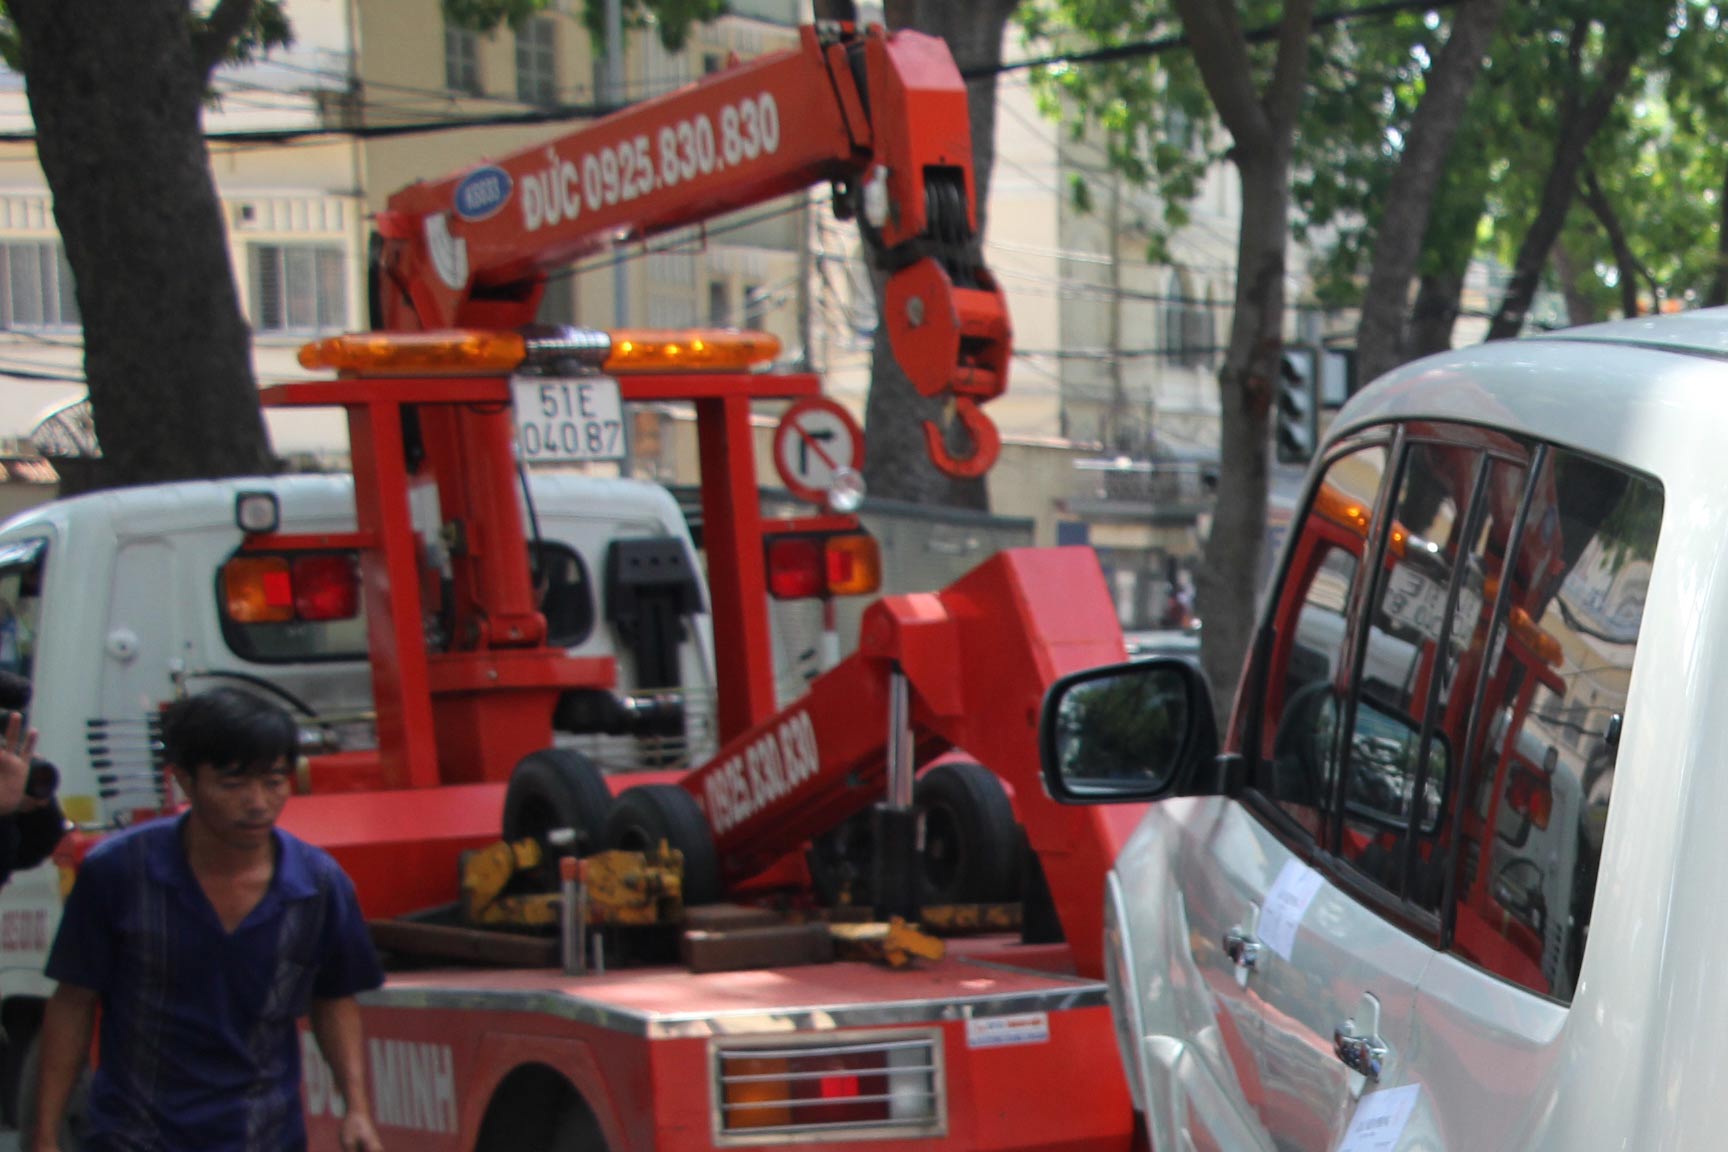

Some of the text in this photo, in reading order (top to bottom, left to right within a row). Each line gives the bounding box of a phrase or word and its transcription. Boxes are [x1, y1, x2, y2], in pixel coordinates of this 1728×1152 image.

[583, 91, 780, 211] 0925.830.830
[538, 383, 597, 418] 51E
[369, 1037, 459, 1135] MINH
